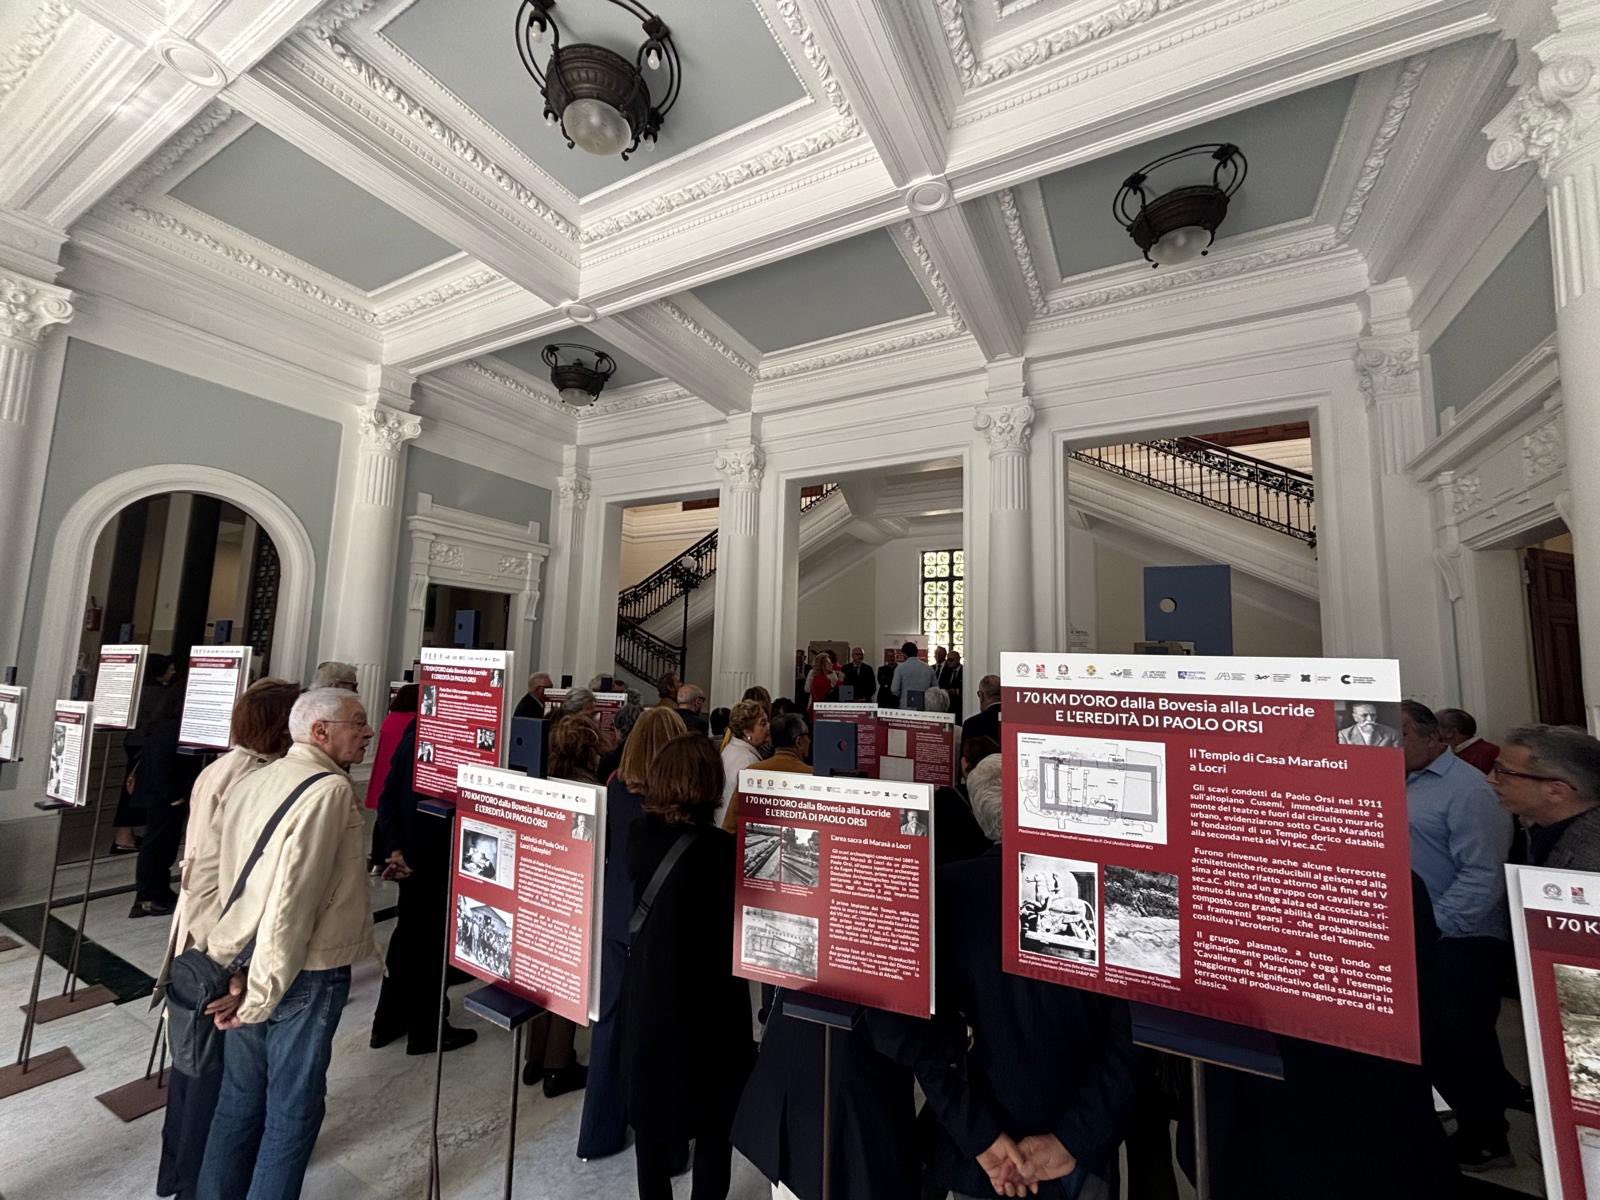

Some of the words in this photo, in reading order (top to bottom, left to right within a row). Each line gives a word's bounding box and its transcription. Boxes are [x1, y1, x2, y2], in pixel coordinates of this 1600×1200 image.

[1023, 691, 1040, 703] 70
[1042, 692, 1066, 705] KM
[1069, 693, 1117, 707] D'ORO
[1120, 696, 1155, 709] dalla
[1158, 697, 1216, 712] Bovesia
[1220, 700, 1248, 714] alla
[1252, 701, 1314, 717] Locride
[1055, 709, 1063, 721] E
[1067, 710, 1139, 726] L'EREDITÀ
[1142, 714, 1159, 727] DI
[1163, 715, 1218, 730] PAOLO
[1222, 719, 1262, 733] ORSI
[1189, 748, 1196, 758] Il
[1198, 748, 1240, 762] Tempio
[1242, 752, 1253, 762] di
[1256, 753, 1285, 764] Casa
[1288, 755, 1347, 769] Marafioti
[1198, 762, 1226, 773] Locri
[750, 795, 758, 803] 70
[759, 797, 771, 805] KM
[772, 798, 797, 808] D'ORO
[797, 800, 815, 810] dalla
[816, 802, 845, 813] Bovesia
[846, 806, 860, 814] alla
[861, 807, 891, 818] Locride
[1190, 793, 1244, 804] sull'altopiano
[1250, 798, 1284, 809] Cusemi,
[1291, 801, 1370, 816] immediatamente
[1192, 783, 1204, 791] Gli
[1231, 788, 1267, 797] condotti
[1270, 790, 1282, 798] da
[1285, 791, 1311, 801] Paolo
[1314, 794, 1334, 803] Orsi
[1338, 797, 1353, 805] nel
[1358, 799, 1382, 808] 1911
[764, 807, 770, 816] E
[771, 808, 807, 820] L'EREDITÀ
[808, 812, 817, 821] DI
[818, 813, 846, 824] PAOLO
[846, 816, 866, 826] ORSI
[1190, 811, 1221, 821] urbano,
[1223, 814, 1284, 827] evidenziarono
[1313, 823, 1336, 832] Casa
[1339, 826, 1384, 838] Marafioti
[1217, 804, 1230, 812] del
[1232, 806, 1259, 815] teatro
[1268, 809, 1289, 818] fuori
[1291, 811, 1305, 819] dal
[1307, 813, 1343, 823] circuito
[1345, 818, 1384, 828] murario
[1190, 819, 1198, 827] le
[1201, 820, 1244, 832] fondazioni
[1274, 828, 1307, 839] Tempio
[1311, 833, 1341, 843] dorico
[1344, 837, 1384, 848] databile
[1206, 831, 1240, 840] seconda
[1241, 835, 1263, 843] metà
[1265, 837, 1278, 845] del
[1280, 838, 1291, 847] VI
[1292, 842, 1326, 851] sec.a.C.
[1191, 857, 1255, 870] architettoniche
[1256, 865, 1311, 878] riconducibili
[1313, 872, 1321, 880] al
[1322, 874, 1354, 884] geison
[1369, 880, 1387, 889] alla
[1194, 847, 1223, 857] Furono
[1227, 851, 1268, 863] rinvenute
[1271, 858, 1298, 867] anche
[1302, 861, 1332, 871] alcune
[1336, 866, 1386, 878] terrecotte
[1191, 865, 1210, 874] sima
[1212, 868, 1225, 876] del
[1228, 870, 1250, 879] tetto
[1252, 873, 1280, 884] rifatto
[1283, 878, 1317, 889] attorno
[1320, 883, 1337, 892] alla
[1340, 885, 1358, 895] fine
[1360, 888, 1376, 897] del
[1379, 891, 1387, 899] V
[1191, 875, 1221, 885] sec.a.C.
[1223, 879, 1244, 888] oltre
[1273, 887, 1305, 897] gruppo
[1307, 892, 1324, 900] con
[1326, 895, 1370, 907] cavaliere
[1192, 884, 1223, 894] stenuto
[1224, 888, 1235, 896] da
[1236, 891, 1253, 899] una
[1254, 893, 1280, 904] sfinge
[1281, 897, 1304, 907] alata
[1319, 904, 1369, 917] accosciata
[1377, 912, 1388, 920] ri-
[1192, 894, 1232, 905] composto
[1251, 903, 1281, 913] grande
[1283, 907, 1312, 918] abilità
[1314, 912, 1326, 920] da
[1327, 916, 1389, 930] numerosissi-
[1192, 913, 1233, 925] costituiva
[1235, 918, 1280, 932] l'acroterio
[1281, 928, 1319, 939] centrale
[1320, 933, 1335, 942] del
[1337, 935, 1375, 949] Tempio.
[1207, 904, 1251, 918] frammenti
[1256, 914, 1282, 923] sparsi
[1296, 919, 1313, 928] che
[1318, 924, 1389, 941] probabilmente
[1556, 917, 1581, 932] 70
[1584, 920, 1600, 935] K
[1194, 977, 1228, 990] classica.
